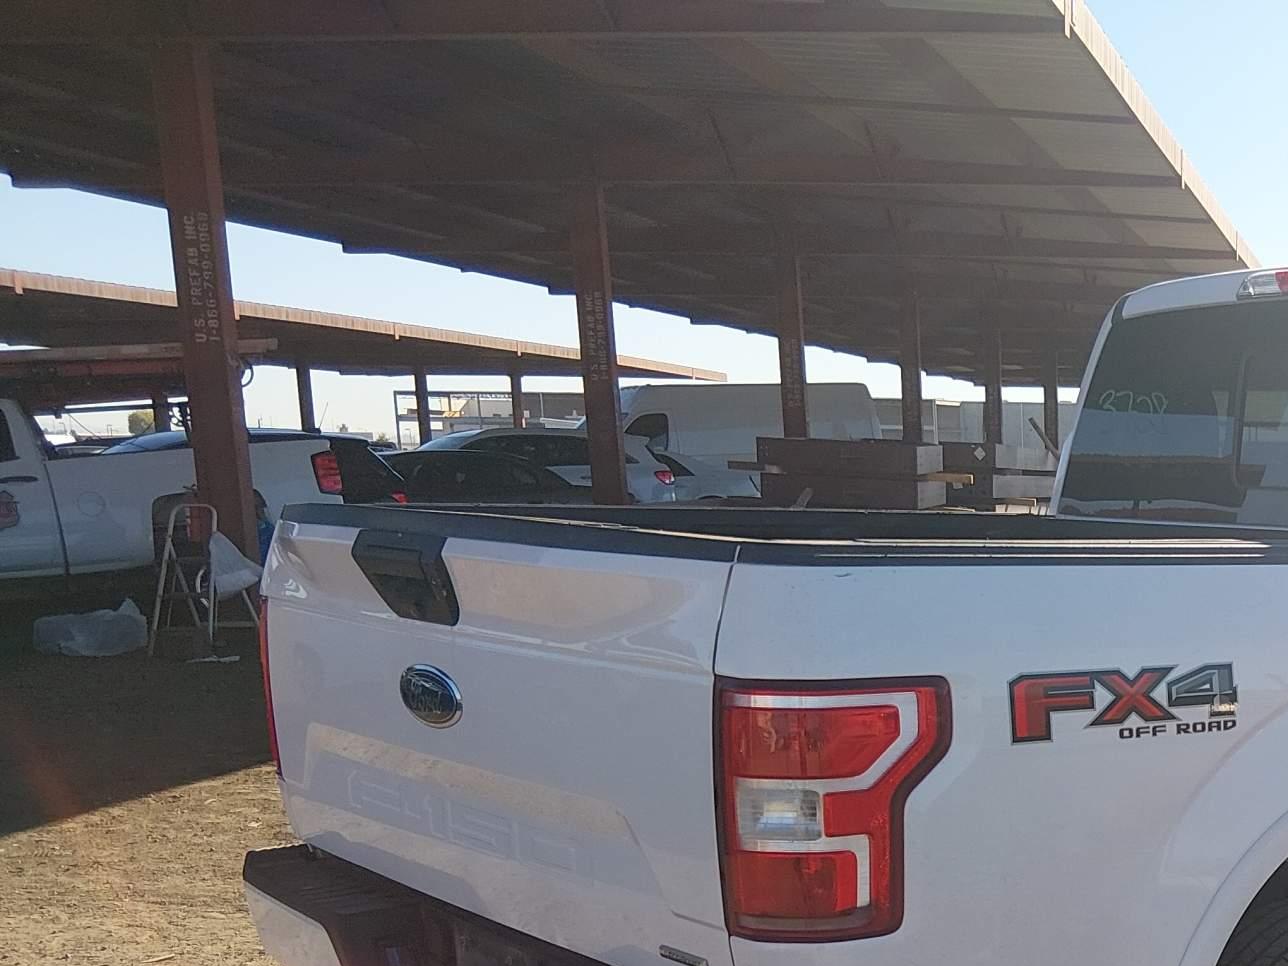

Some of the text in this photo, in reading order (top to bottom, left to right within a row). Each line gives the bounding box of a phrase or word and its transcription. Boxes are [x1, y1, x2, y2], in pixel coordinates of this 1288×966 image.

[187, 247, 201, 306] PREFAB
[1009, 663, 1237, 745] FX4
[1119, 719, 1238, 740] OFF ROAD
